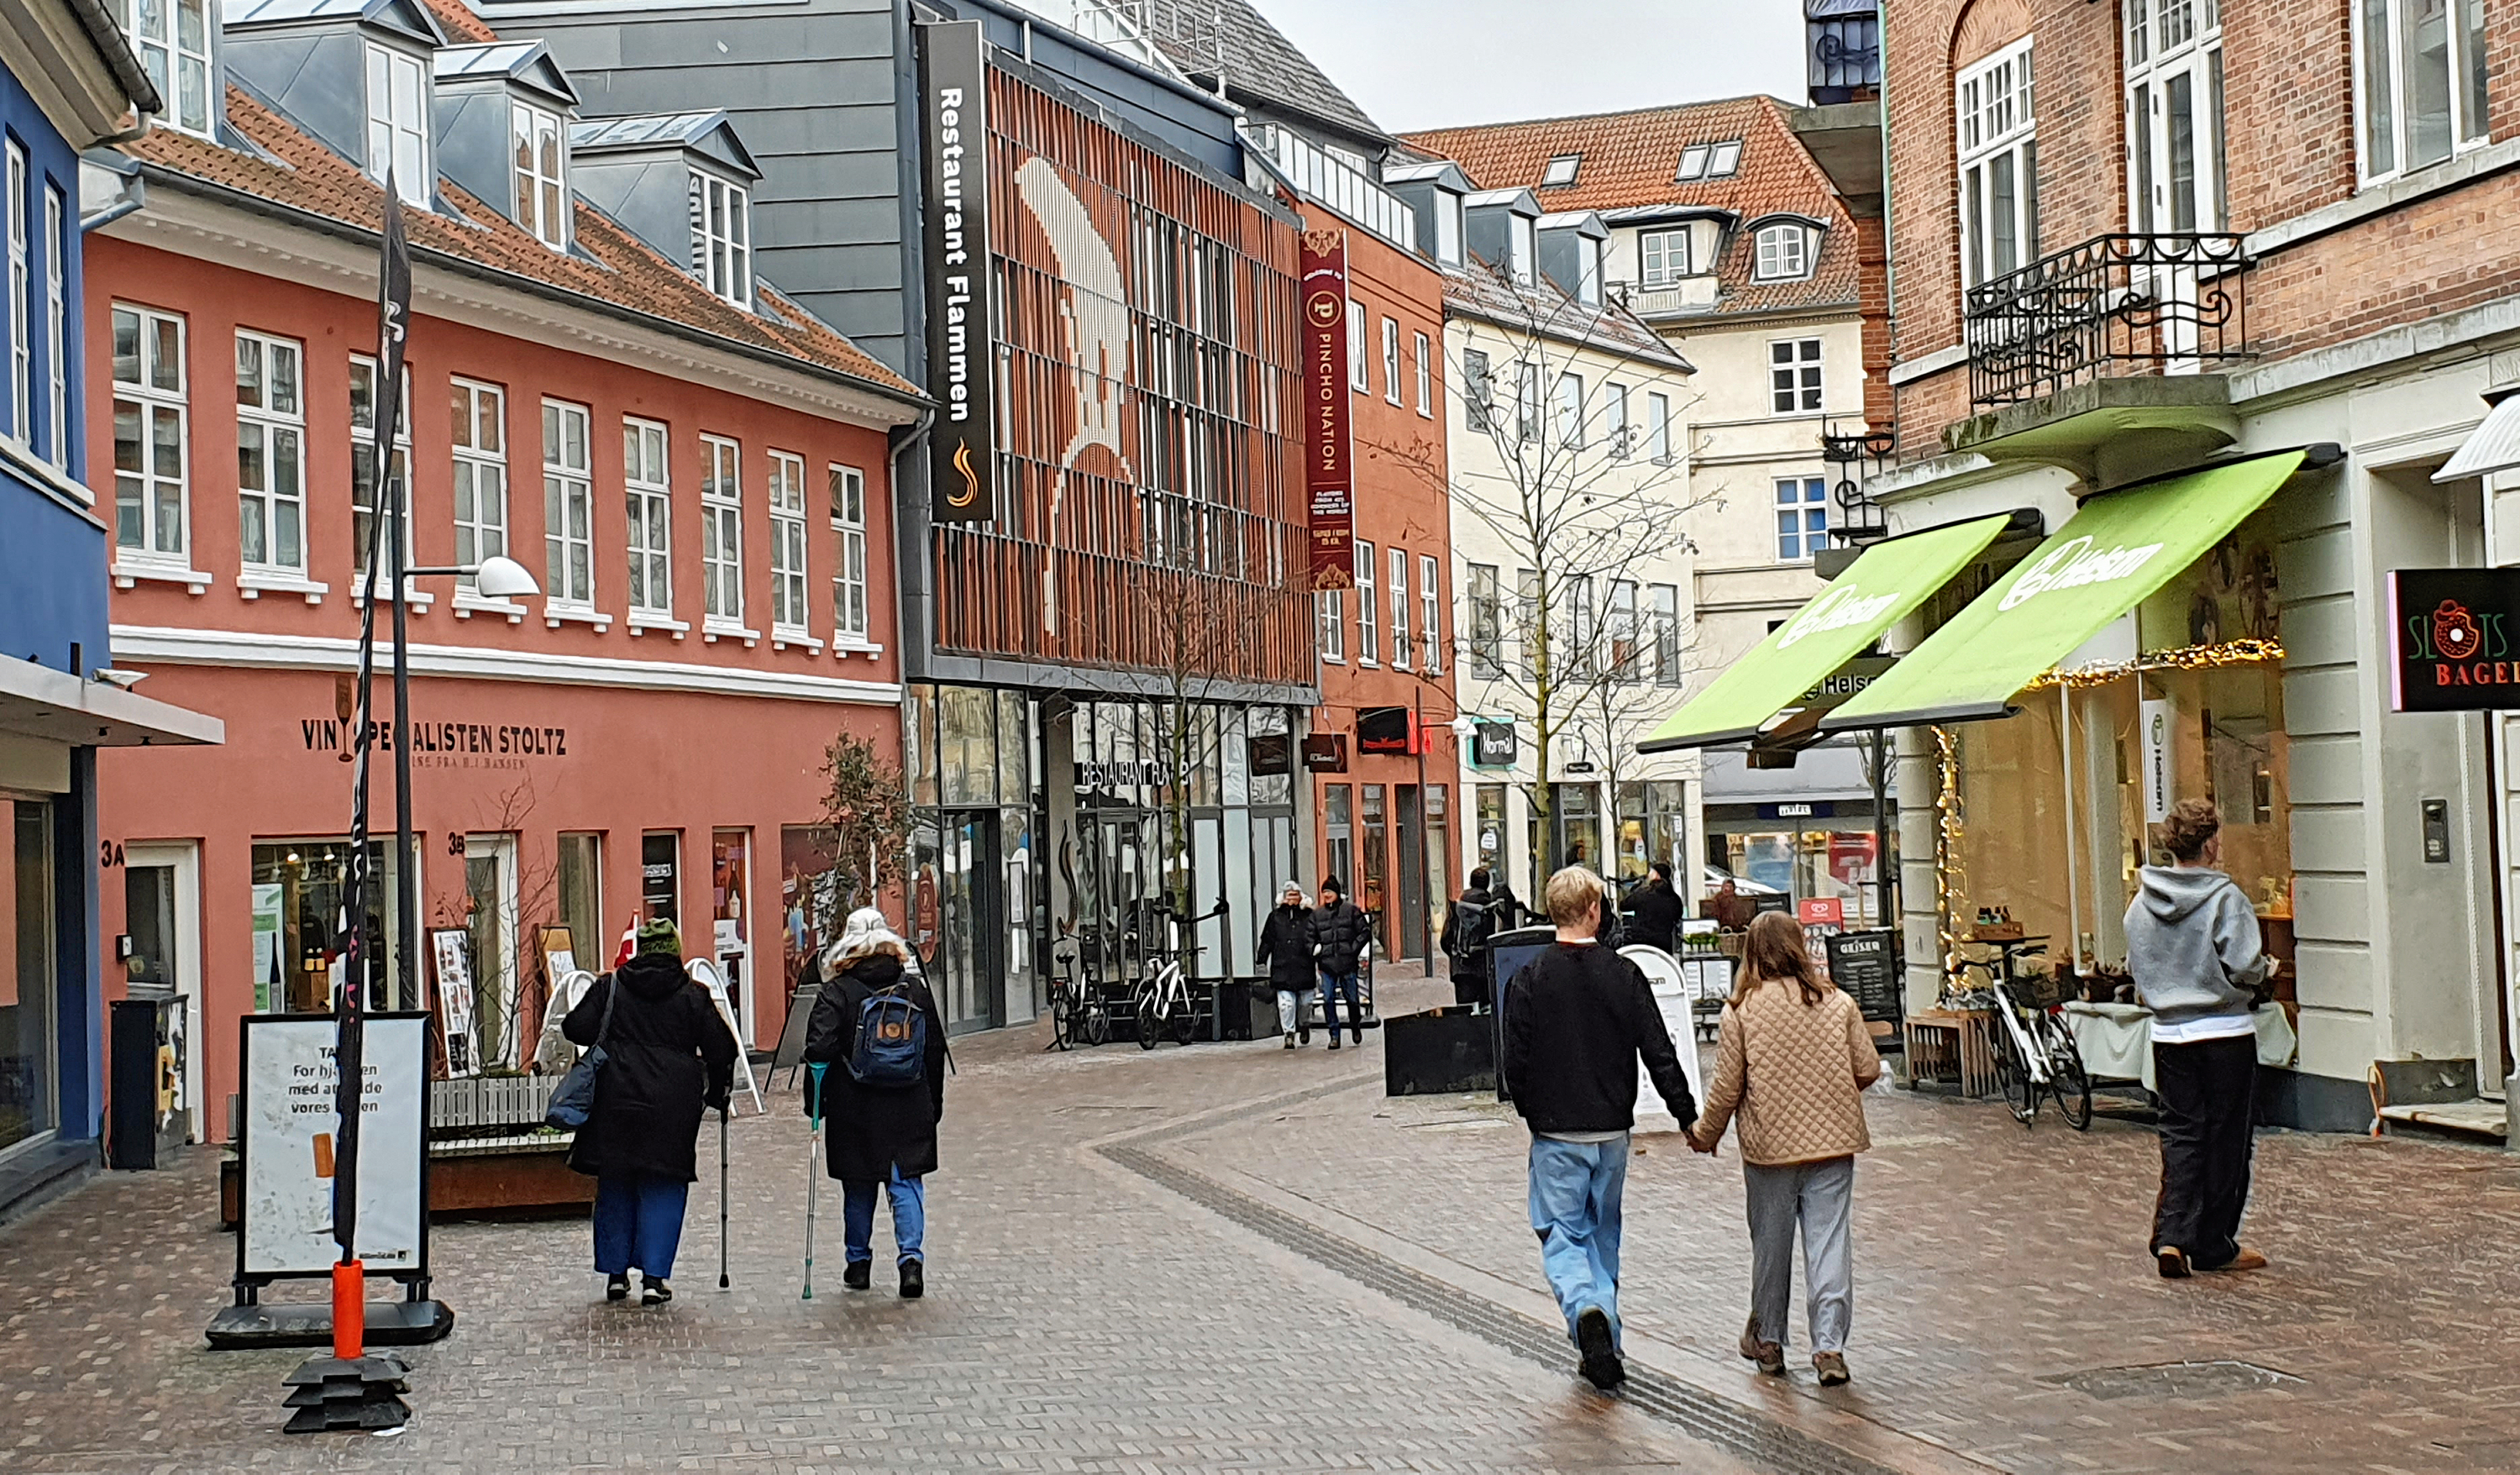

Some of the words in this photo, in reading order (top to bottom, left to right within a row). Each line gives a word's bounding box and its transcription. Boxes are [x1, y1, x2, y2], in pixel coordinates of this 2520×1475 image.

[940, 87, 967, 265] Restaurant
[946, 276, 971, 421] Flammen
[1319, 333, 1334, 401] PINCHO
[1320, 405, 1336, 471] NATION
[301, 719, 337, 750] VIN
[499, 726, 567, 755] STOLTZ
[101, 839, 125, 868] 3A
[448, 831, 465, 856] 3B
[293, 1064, 316, 1077] For
[289, 1083, 318, 1095] med
[291, 1103, 331, 1114] vores
